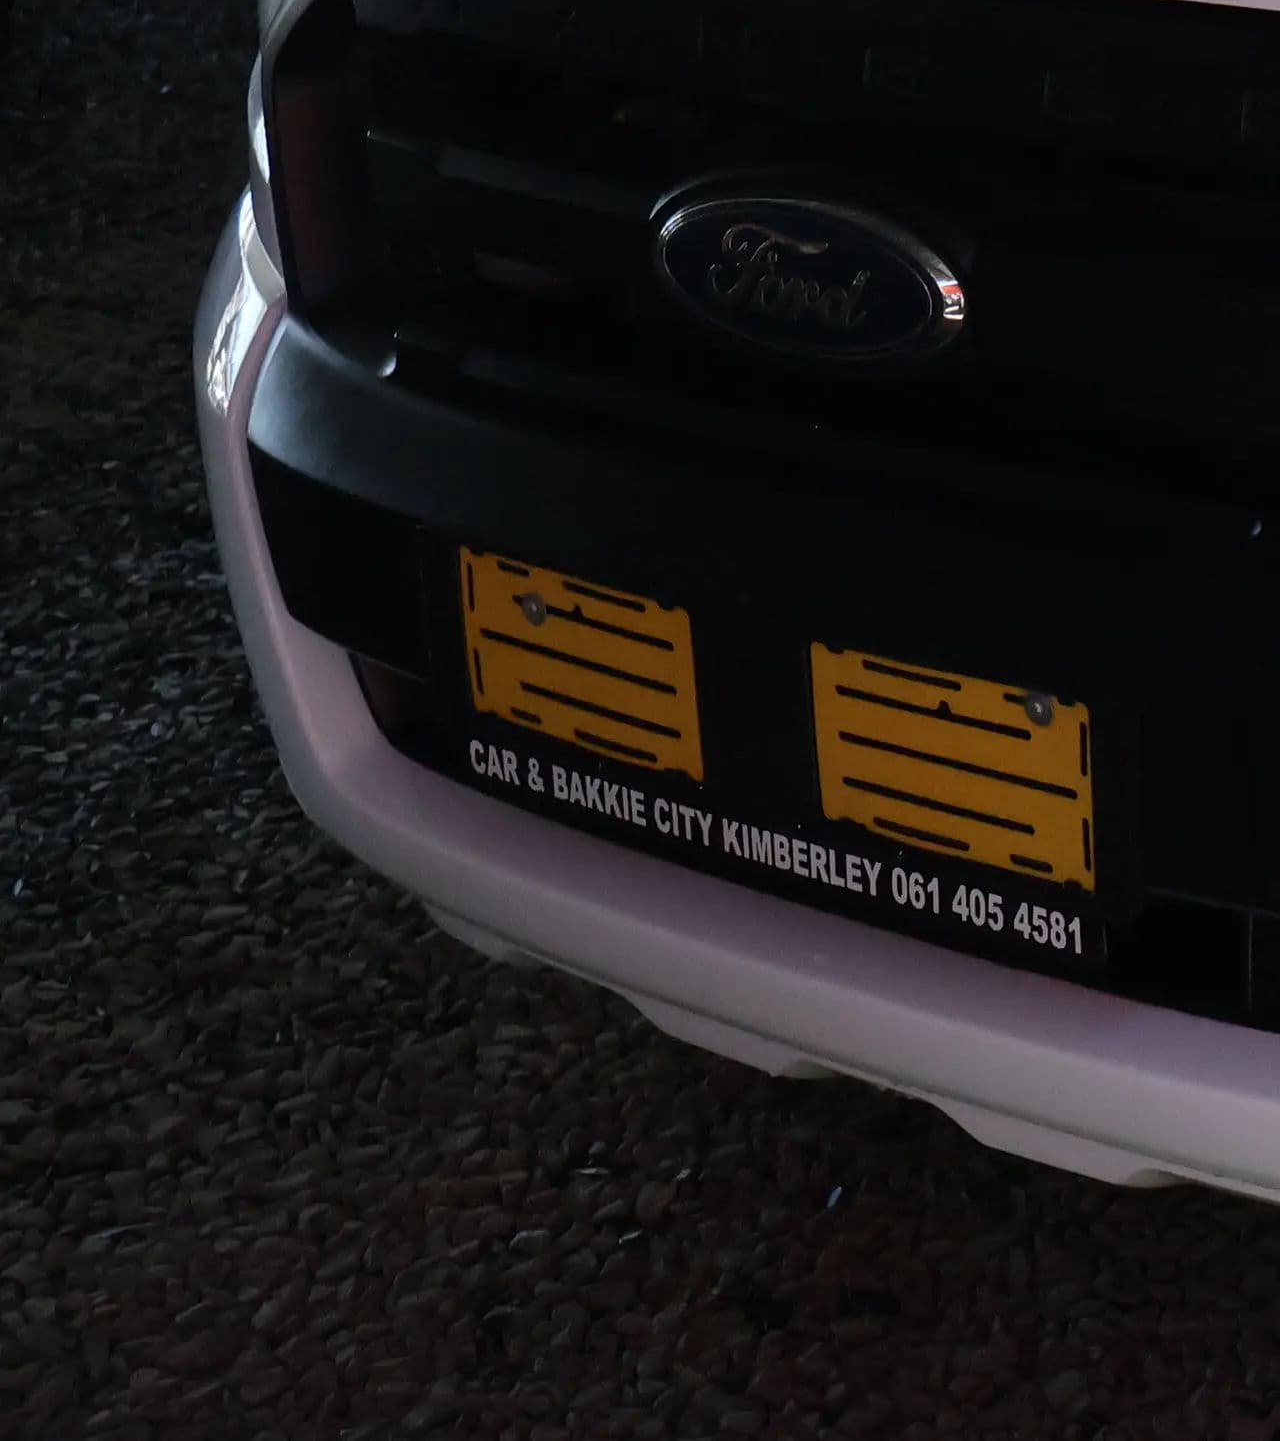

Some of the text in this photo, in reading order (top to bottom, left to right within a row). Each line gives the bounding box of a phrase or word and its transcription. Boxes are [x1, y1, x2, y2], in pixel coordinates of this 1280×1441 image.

[704, 220, 872, 327] Ford
[468, 739, 1083, 955] CAR & BAKKIE CITY KIMBERLEY 061 405 4581
